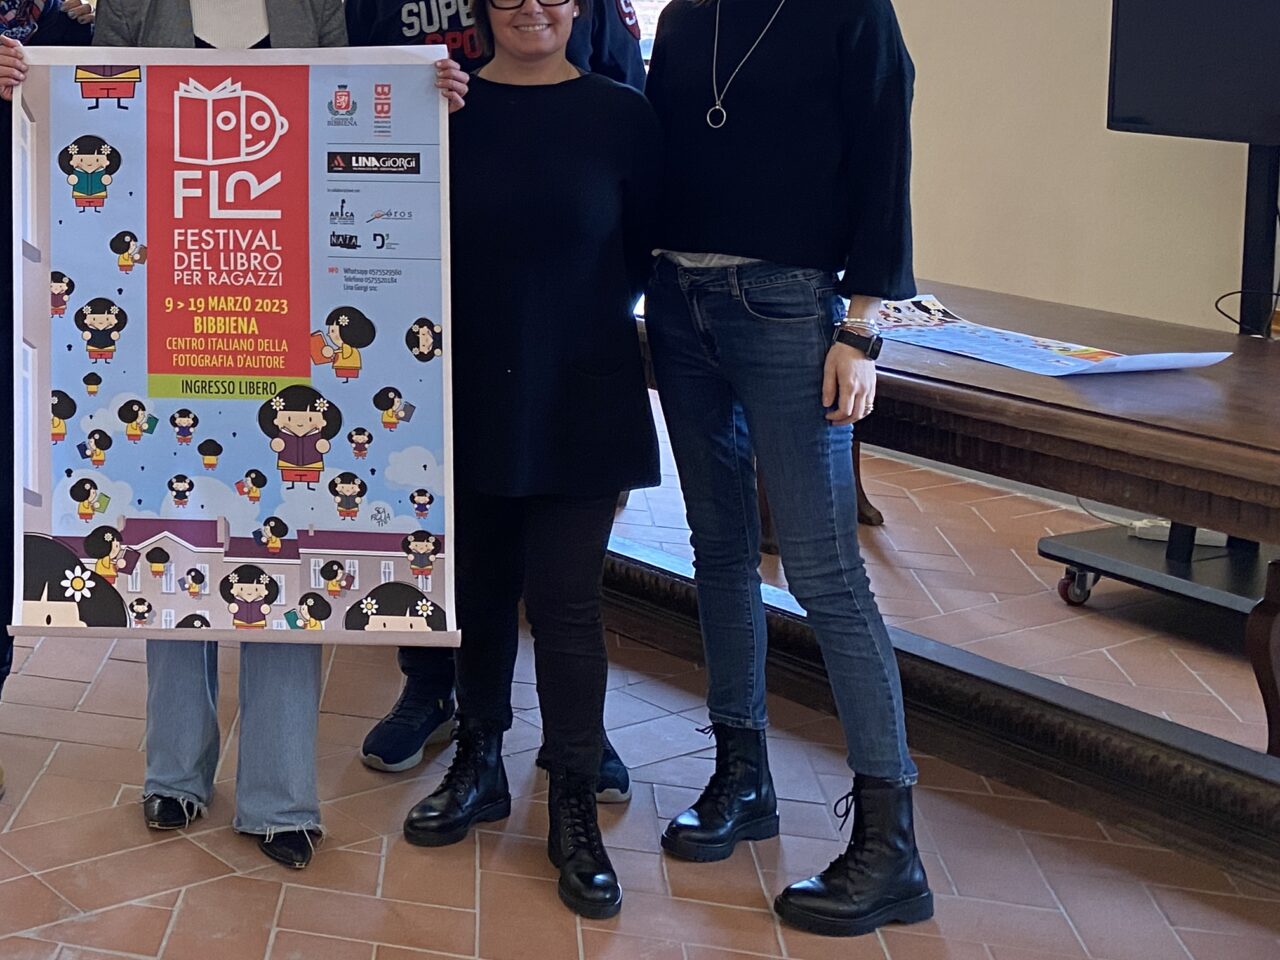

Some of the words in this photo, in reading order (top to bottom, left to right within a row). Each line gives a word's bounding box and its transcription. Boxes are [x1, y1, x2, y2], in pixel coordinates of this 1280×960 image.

[174, 229, 282, 250] FESTIVAL
[174, 252, 212, 270] DEL
[220, 252, 282, 271] LIBRO
[174, 271, 202, 285] PER
[208, 271, 282, 286] RAGAZZI
[165, 297, 174, 312] 9
[188, 298, 205, 313] 19
[208, 296, 251, 312] MARZO
[255, 299, 289, 314] 2023
[193, 316, 259, 335] BIBBIENA
[166, 337, 206, 350] CENTRO
[208, 338, 255, 352] ITALIANO
[257, 339, 289, 352] DELLA
[172, 354, 235, 368] FOTOGRAFIA
[237, 354, 286, 369] D'AUTORE
[181, 379, 235, 395] INGRESSO
[238, 381, 277, 396] LIBERO
